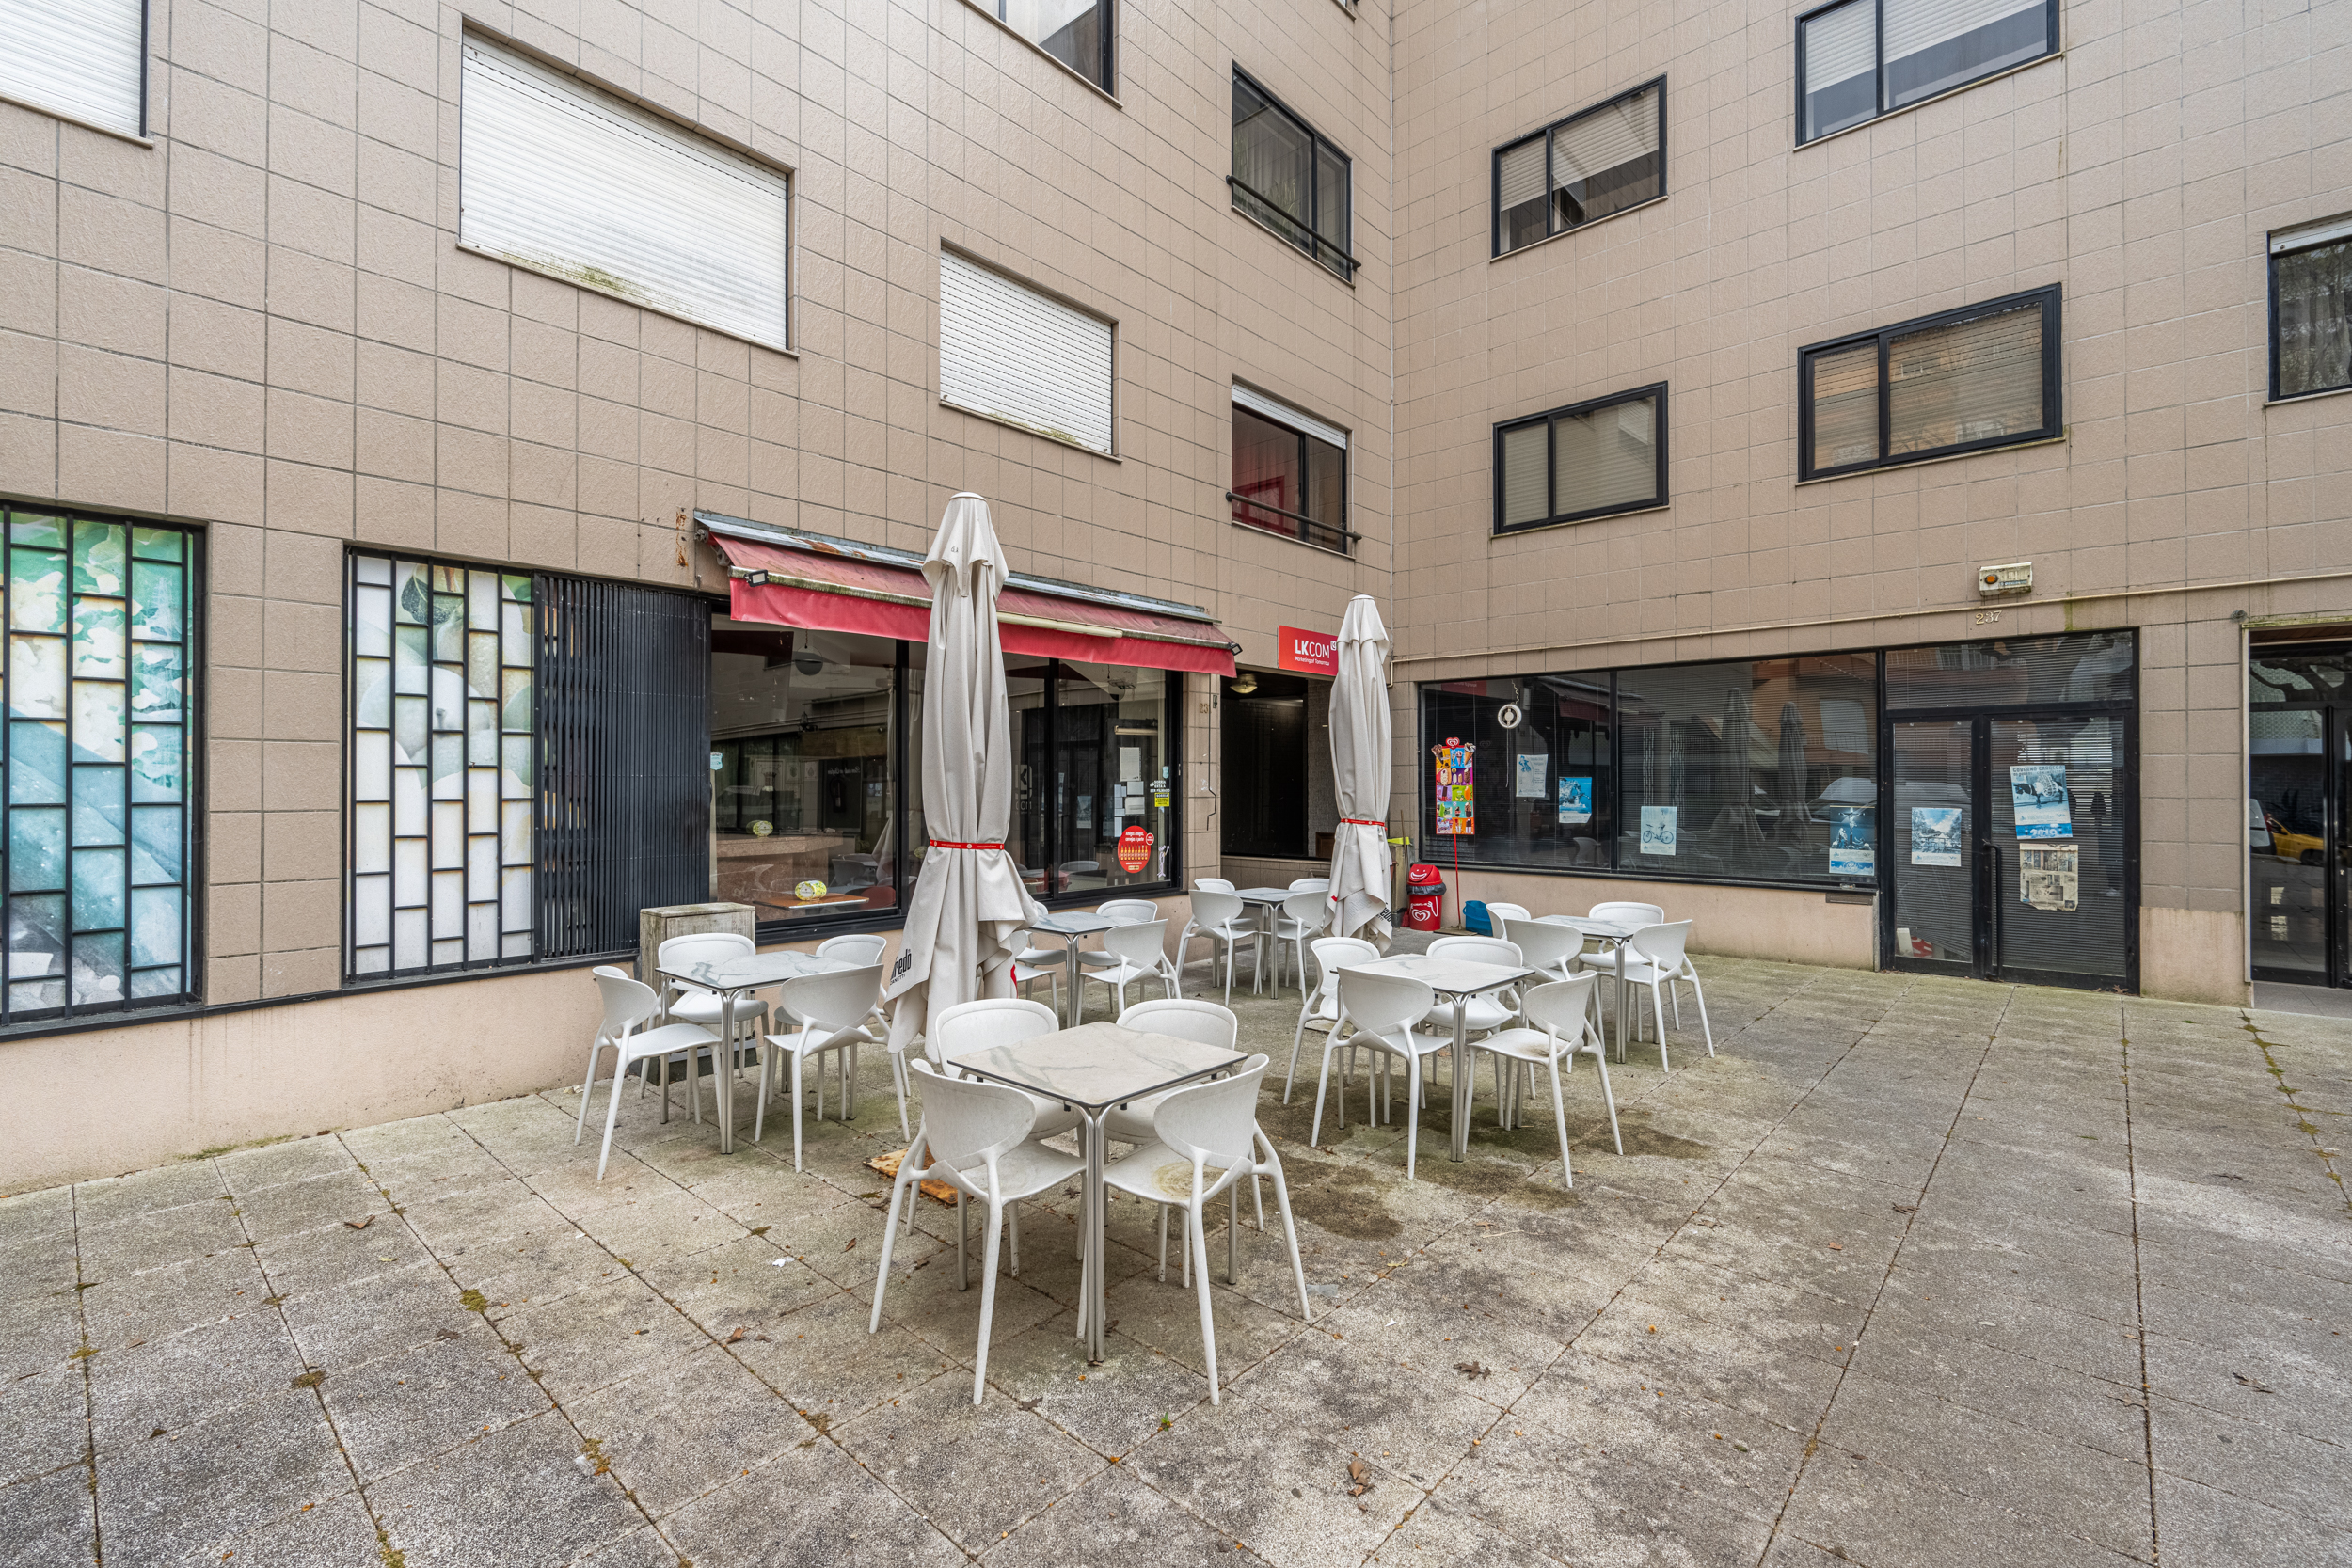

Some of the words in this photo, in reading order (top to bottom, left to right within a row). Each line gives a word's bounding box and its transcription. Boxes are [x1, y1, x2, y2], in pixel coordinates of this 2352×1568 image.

[1975, 610, 2002, 625] 237
[1295, 639, 1330, 659] LKCOM
[1295, 656, 1311, 665] Marketing
[1315, 658, 1330, 667] Tomorrow
